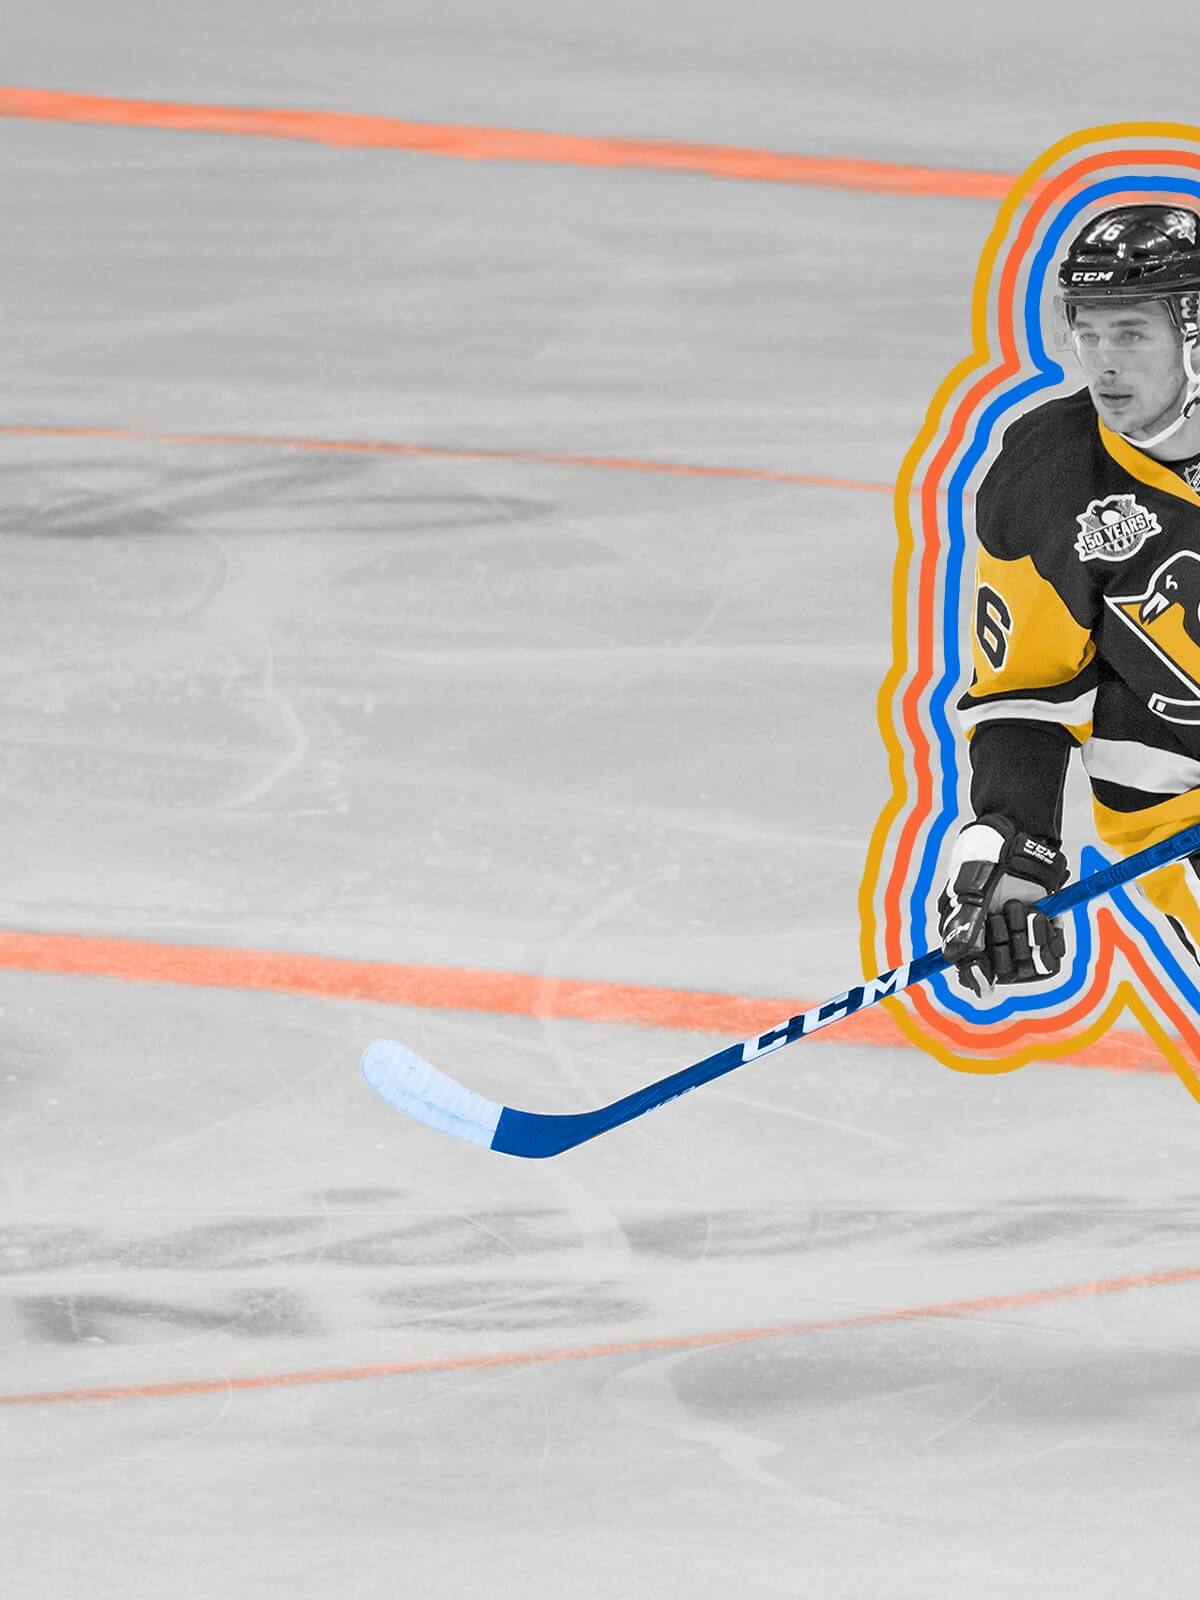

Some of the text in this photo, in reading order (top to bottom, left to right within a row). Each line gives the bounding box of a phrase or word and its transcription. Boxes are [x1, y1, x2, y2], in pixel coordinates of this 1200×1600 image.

[1071, 271, 1114, 281] CCM
[1084, 513, 1147, 549] 50 YEARS
[1025, 838, 1057, 859] CCM
[742, 962, 911, 1061] CCM
